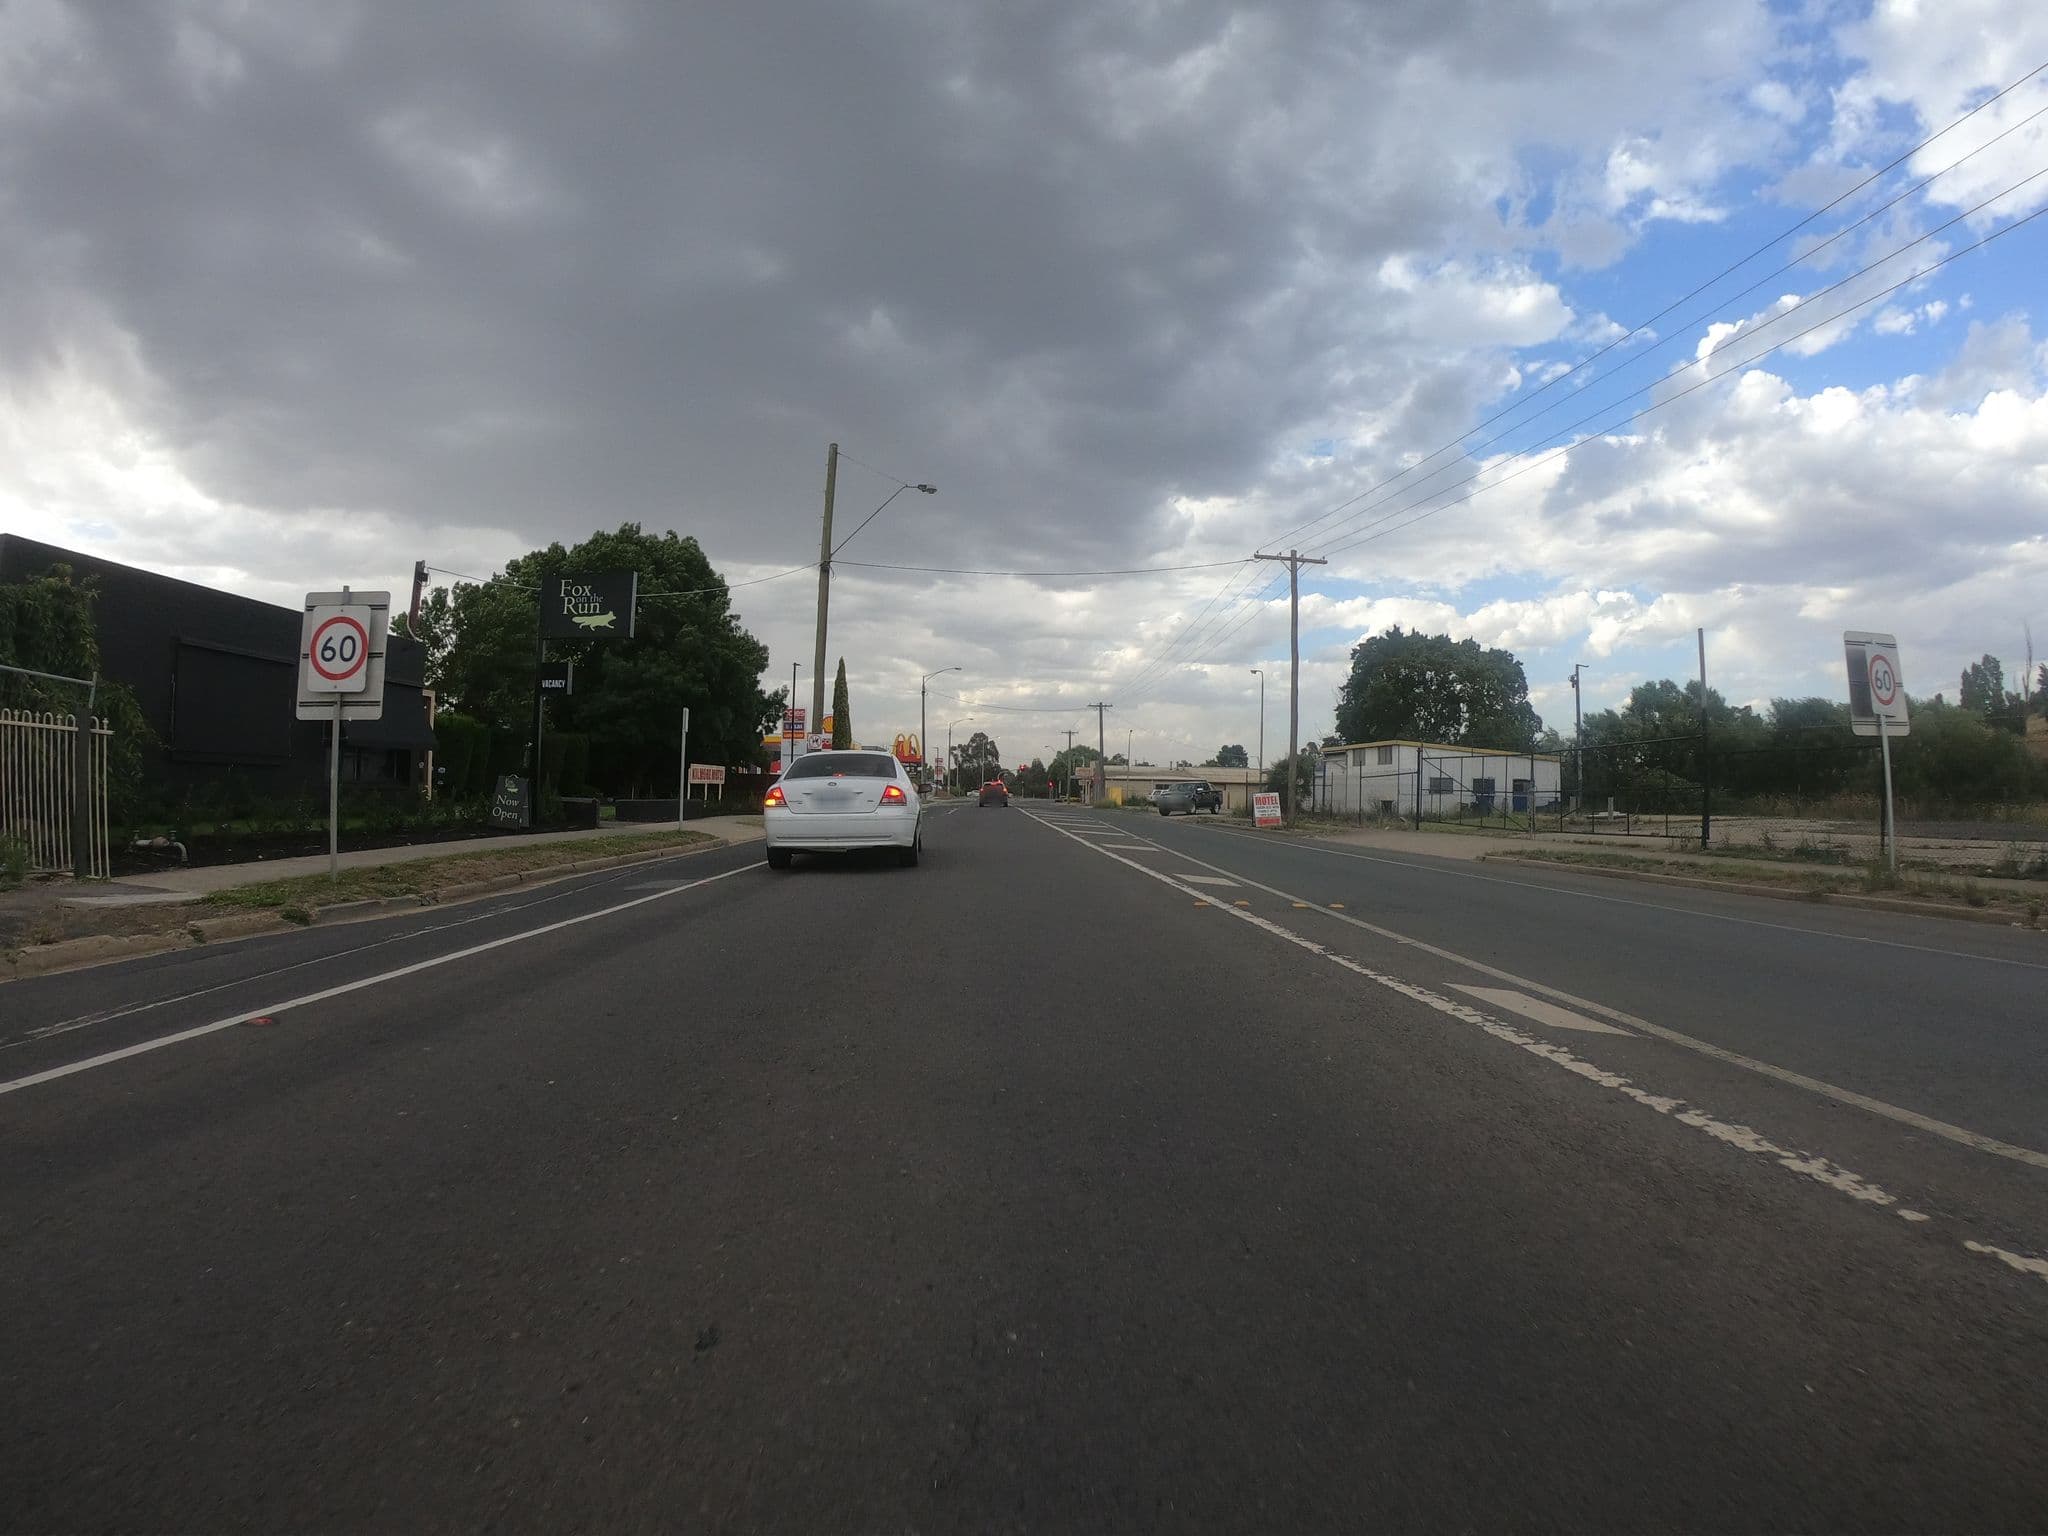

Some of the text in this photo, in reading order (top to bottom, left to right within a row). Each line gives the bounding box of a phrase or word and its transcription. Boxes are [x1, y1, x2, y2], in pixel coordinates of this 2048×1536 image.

[560, 579, 592, 597] Fox
[562, 596, 600, 615] Run
[576, 592, 604, 603] on the
[321, 635, 356, 662] 60
[541, 679, 566, 688] VACANCY
[1875, 669, 1891, 692] 60
[496, 794, 520, 806] Now
[1255, 796, 1279, 806] MOTEL
[492, 806, 519, 822] Open
